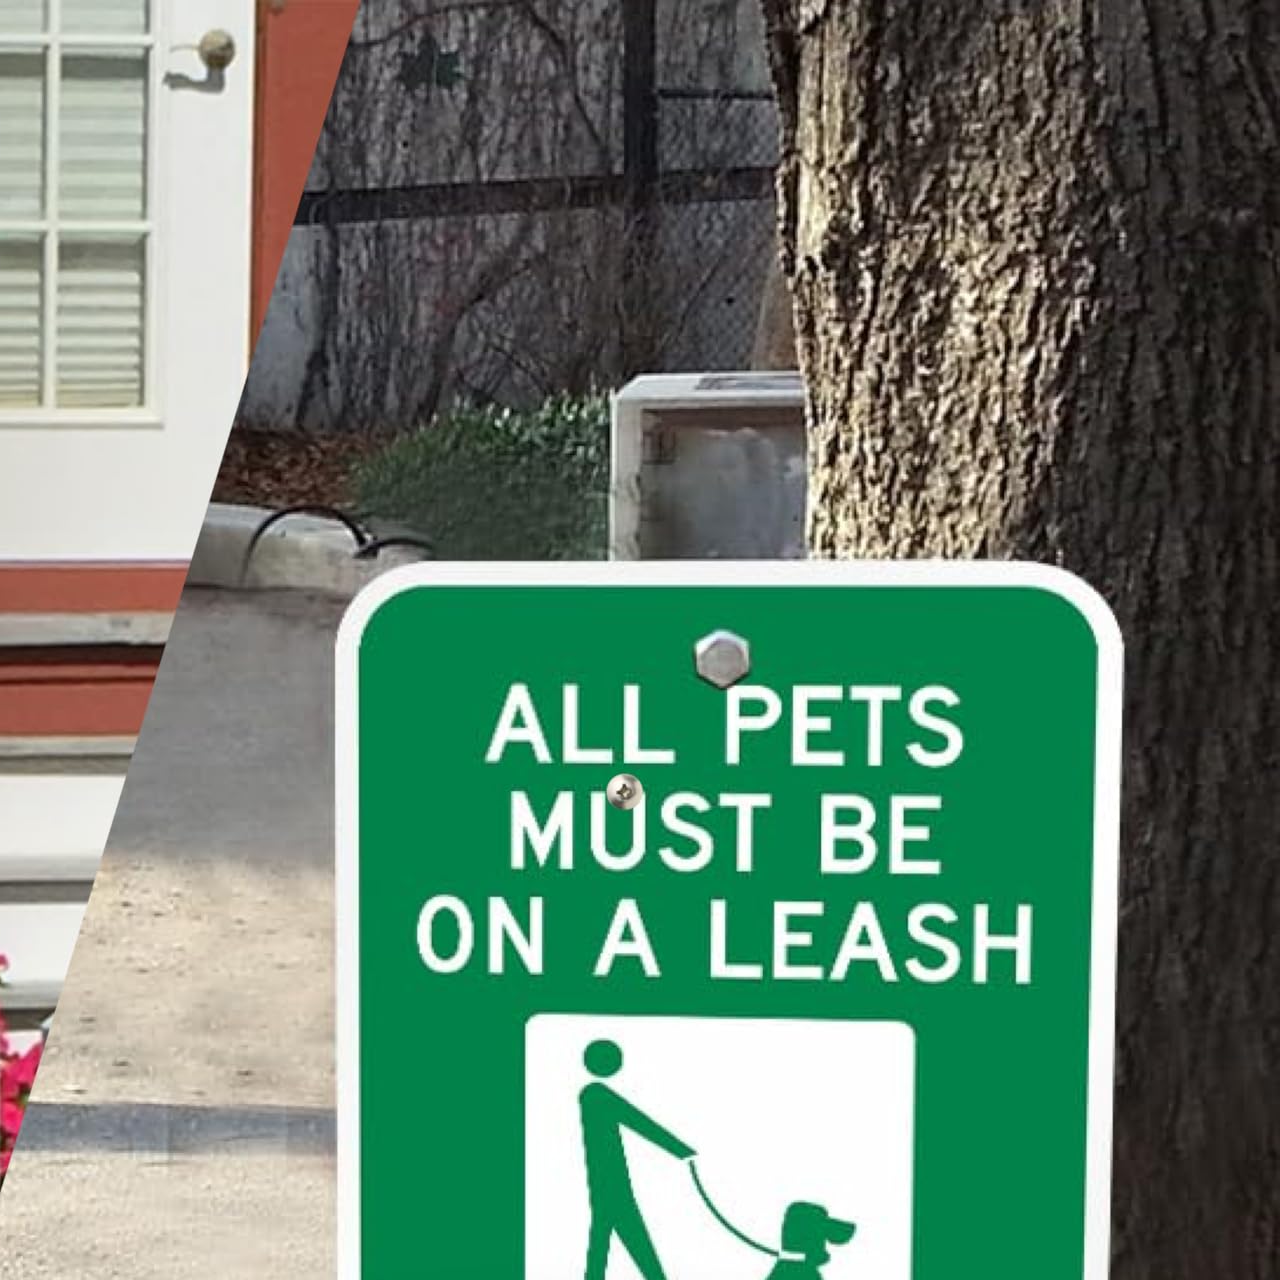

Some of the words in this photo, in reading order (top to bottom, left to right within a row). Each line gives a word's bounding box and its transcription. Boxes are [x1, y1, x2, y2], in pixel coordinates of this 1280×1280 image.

[486, 683, 675, 765] ALL
[726, 684, 963, 768] PETS
[510, 790, 772, 872] MUST
[820, 793, 942, 875] BE
[416, 894, 543, 975] ON
[594, 898, 661, 977] A
[710, 899, 1032, 984] LEASH
